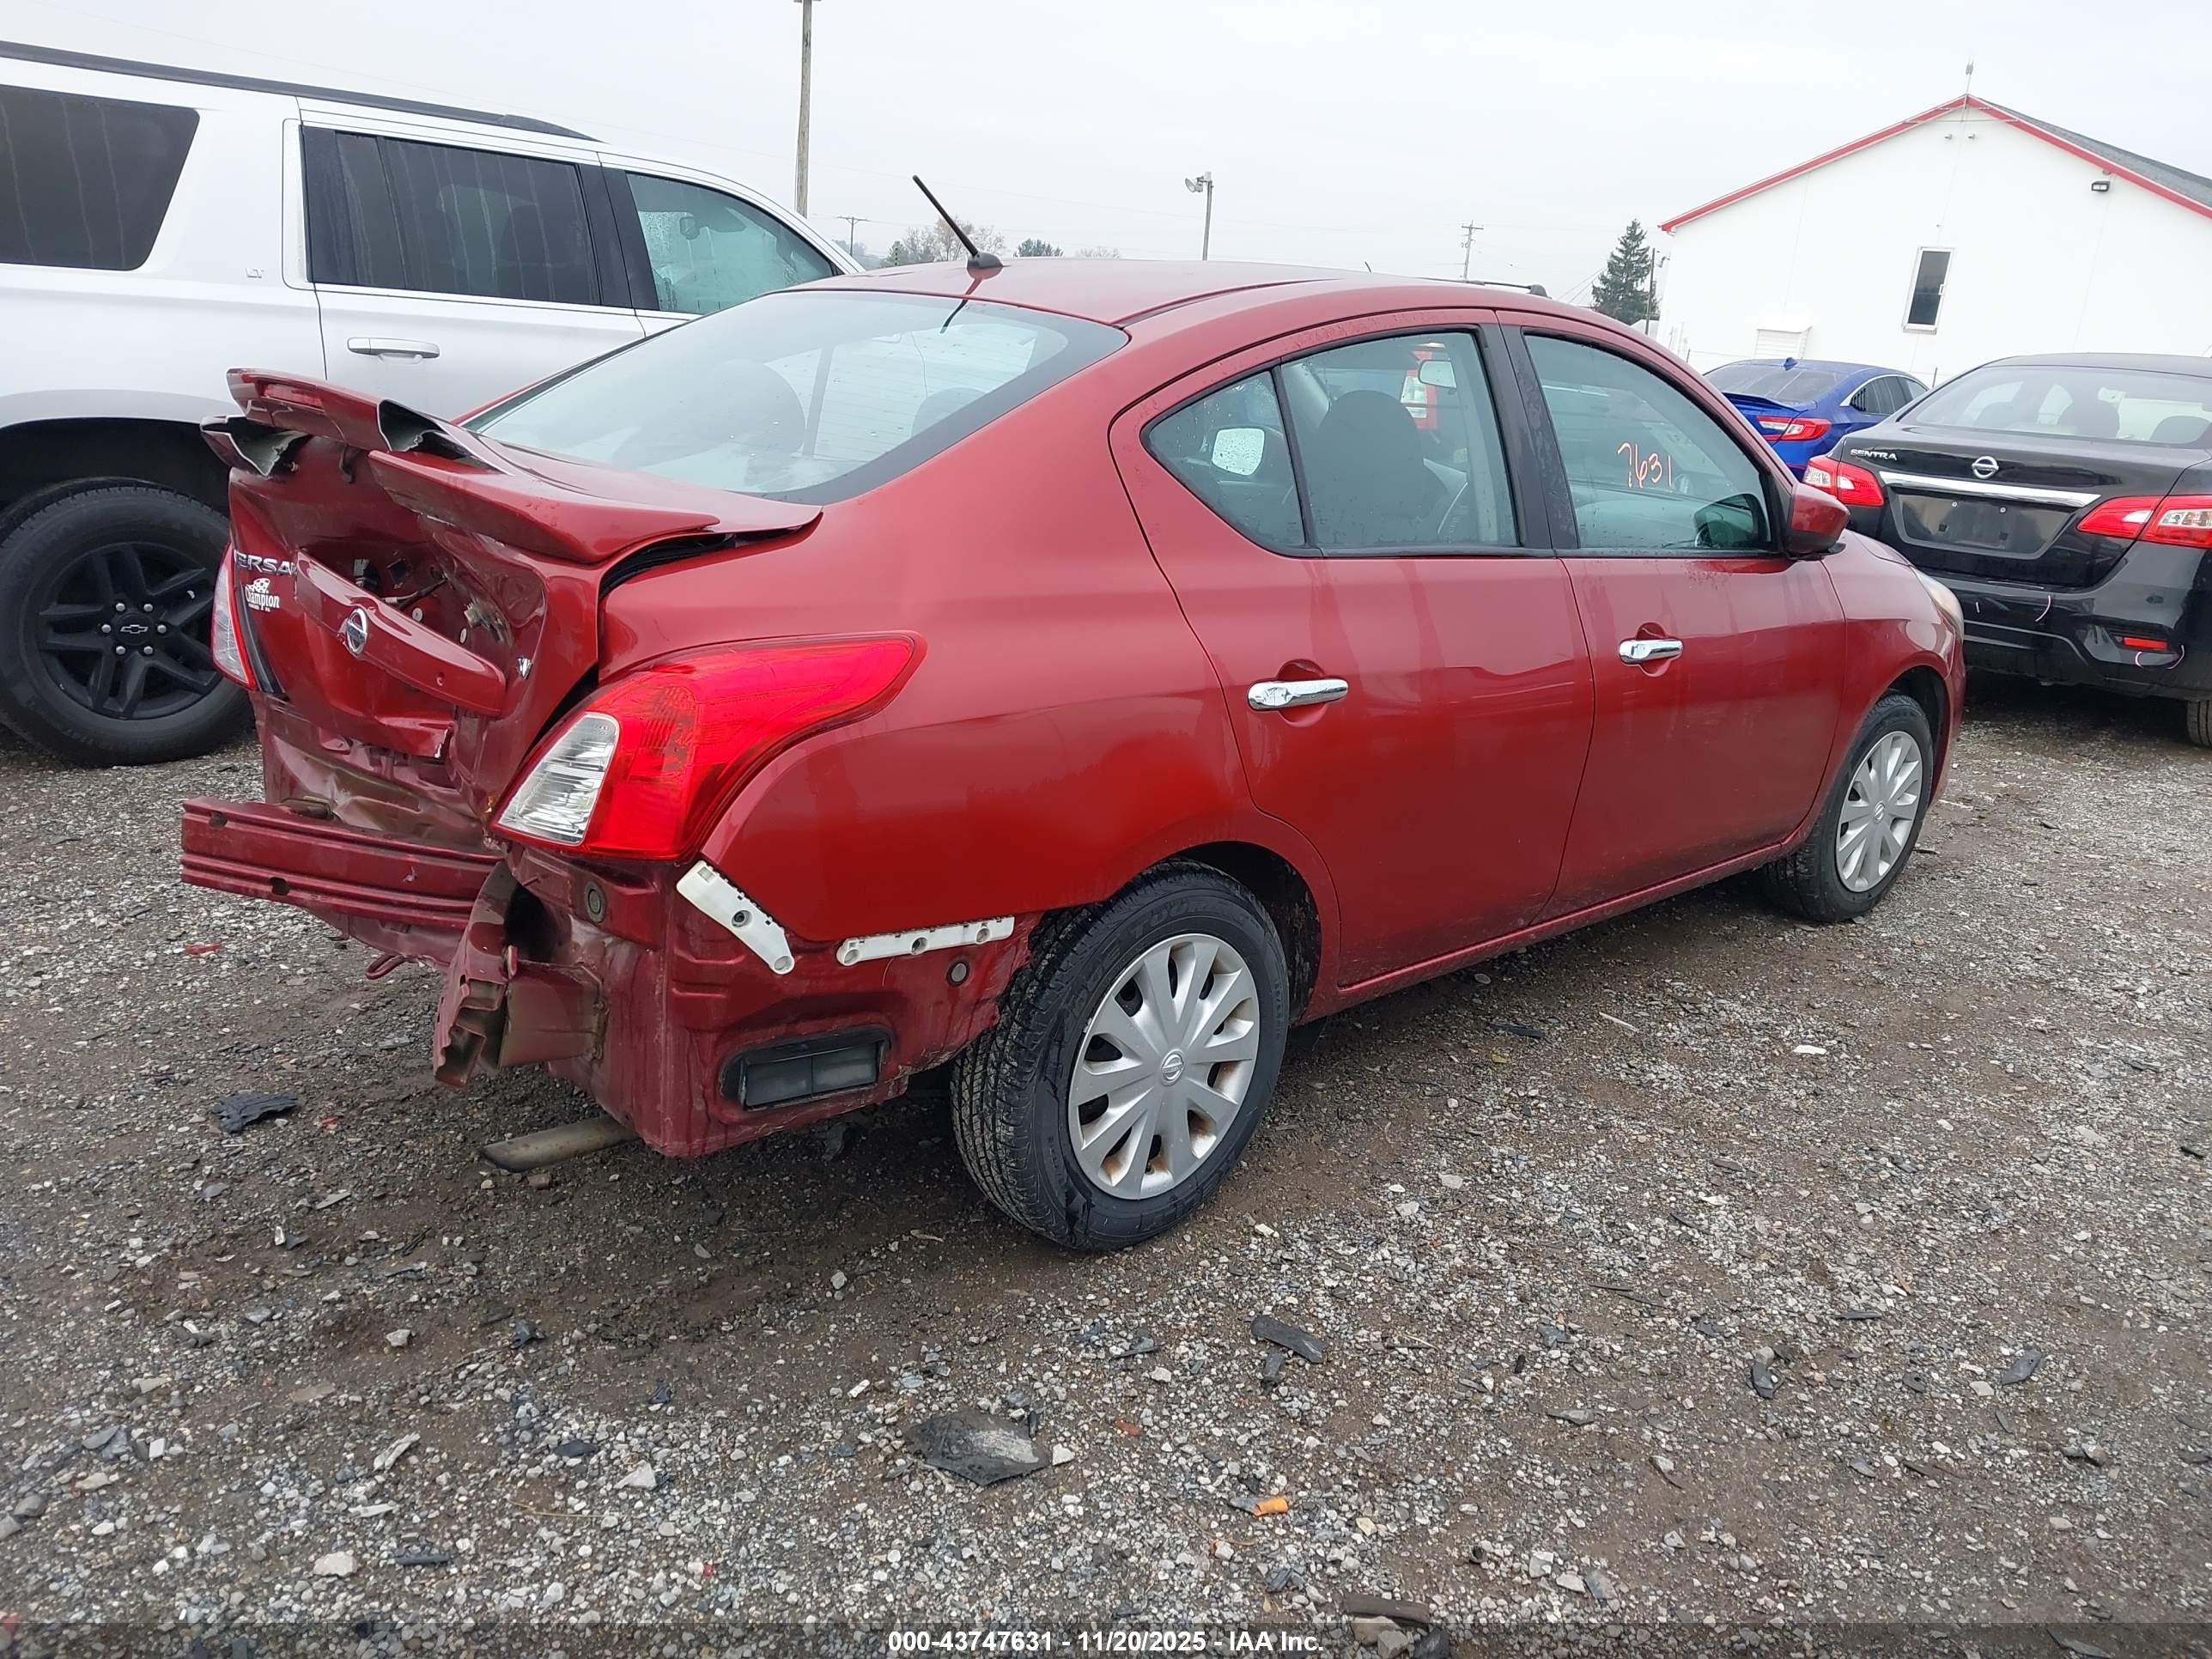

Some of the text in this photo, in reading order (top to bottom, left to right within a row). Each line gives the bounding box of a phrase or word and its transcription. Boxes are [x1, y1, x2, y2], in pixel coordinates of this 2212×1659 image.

[1617, 442, 1673, 489] 7631
[1850, 448, 1898, 461] SENTRA
[234, 550, 293, 575] ERSA
